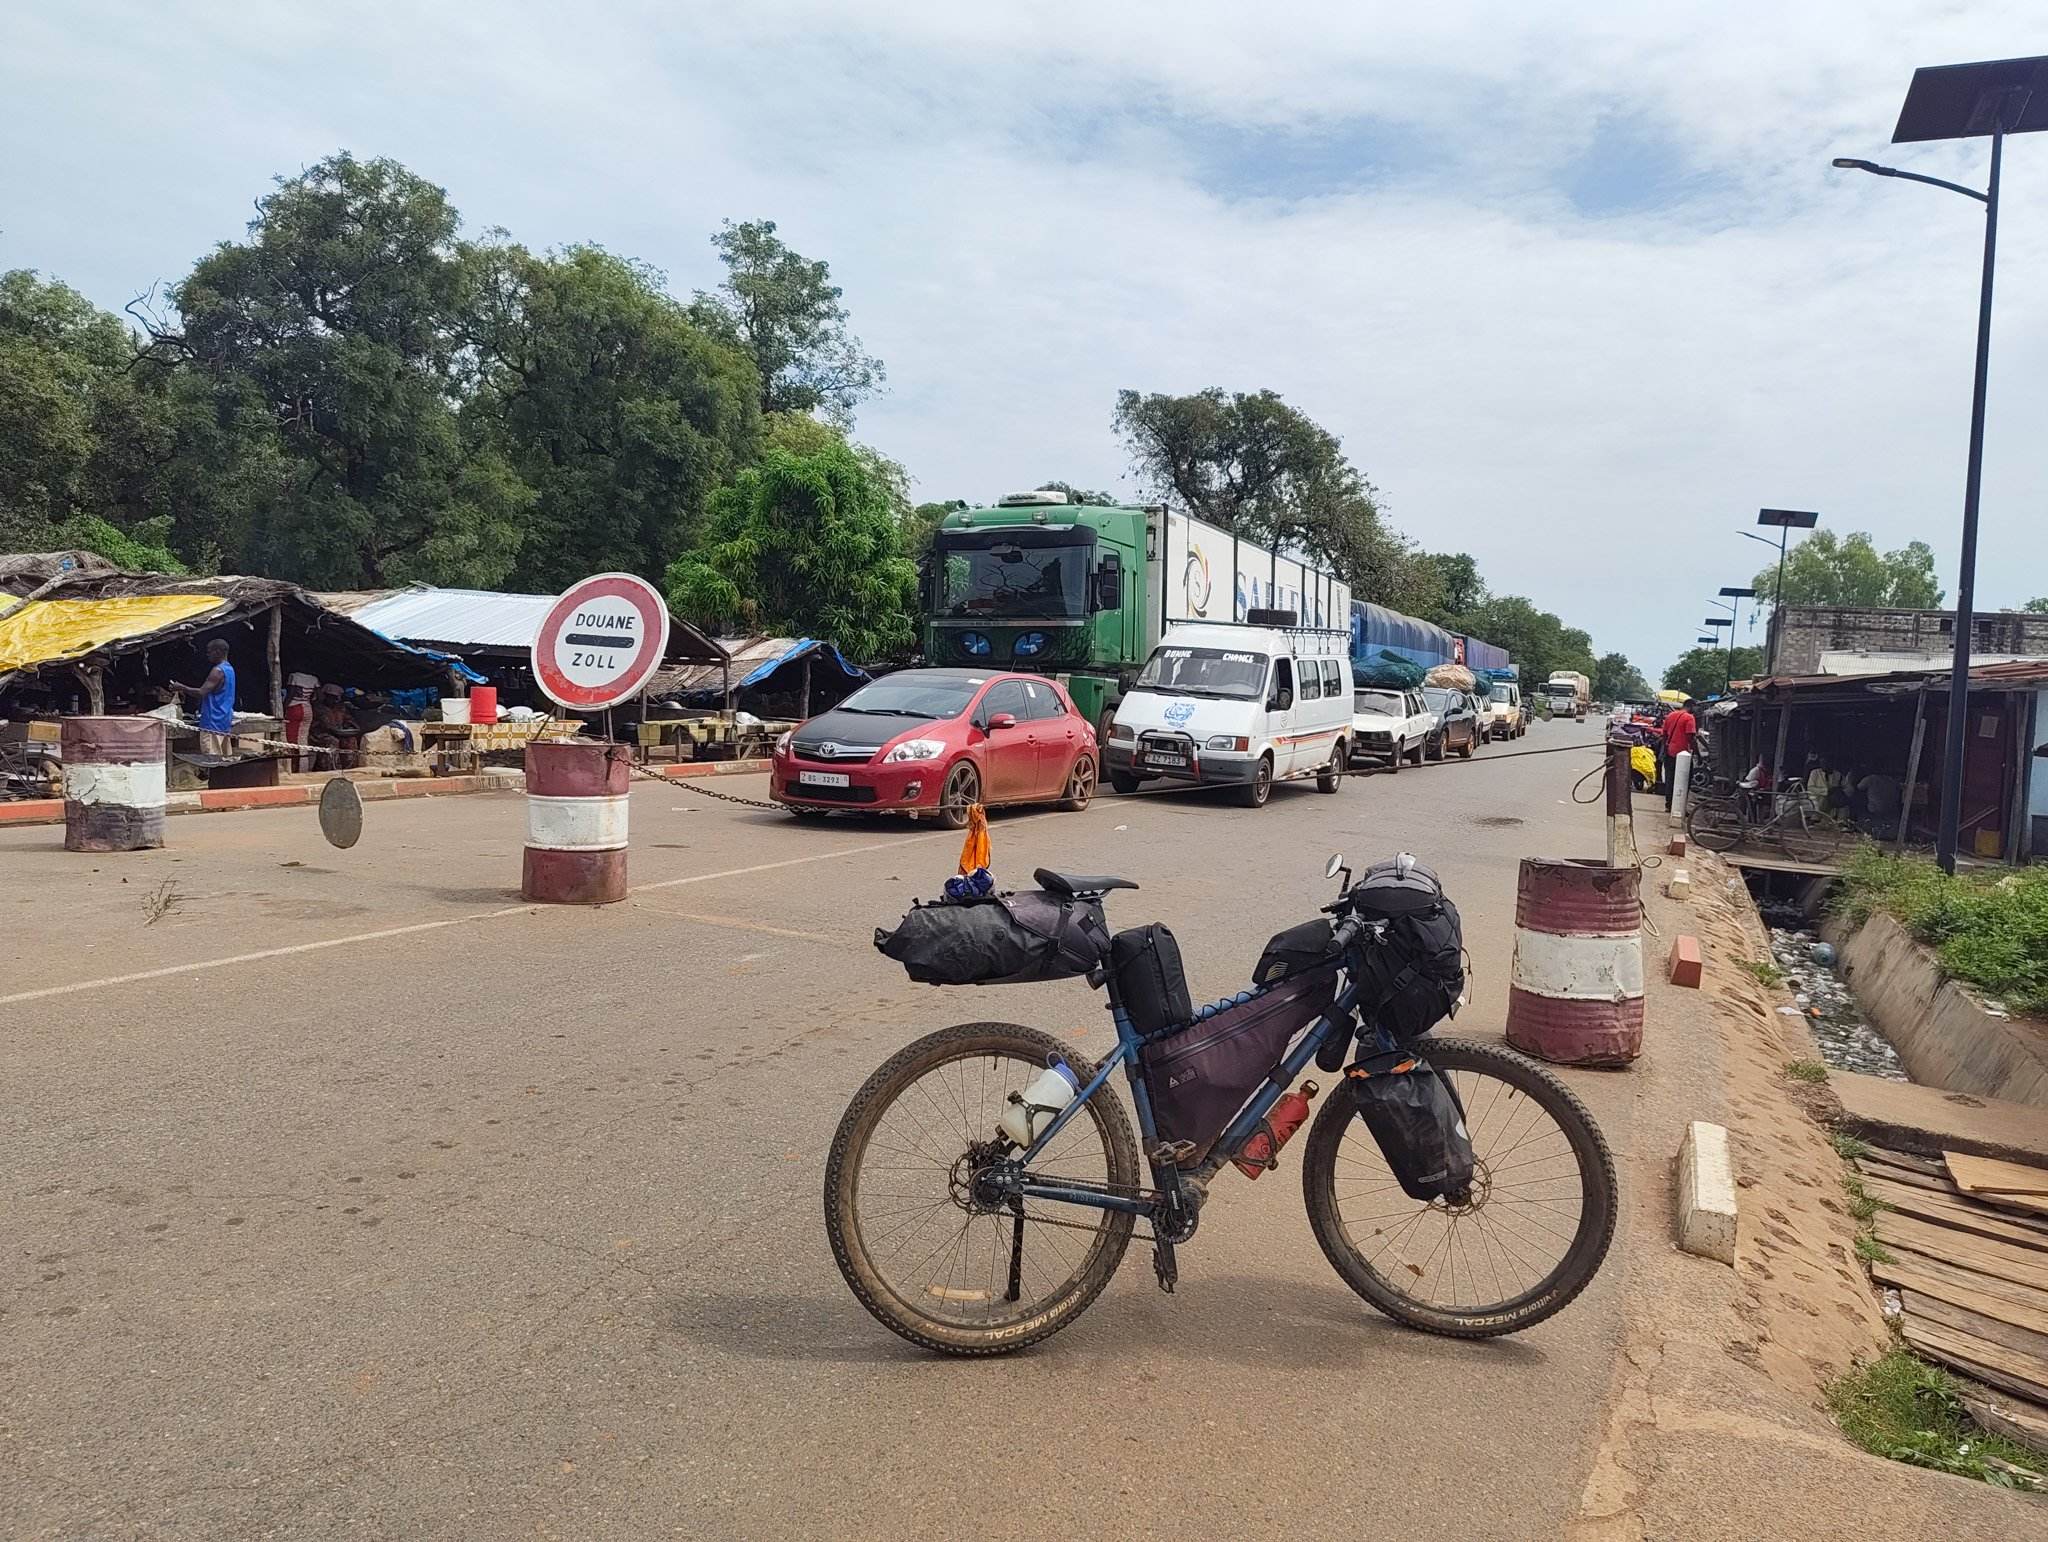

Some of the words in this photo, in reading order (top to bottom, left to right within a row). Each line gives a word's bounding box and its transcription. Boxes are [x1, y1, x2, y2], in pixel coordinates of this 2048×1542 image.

[575, 613, 635, 630] DOUANE
[572, 653, 615, 669] ZOLL
[1164, 649, 1192, 658] BONNE
[1222, 653, 1254, 663] CHANCE
[1454, 1311, 1517, 1326] MEZCAL
[983, 1314, 1048, 1340] MEZCAL
